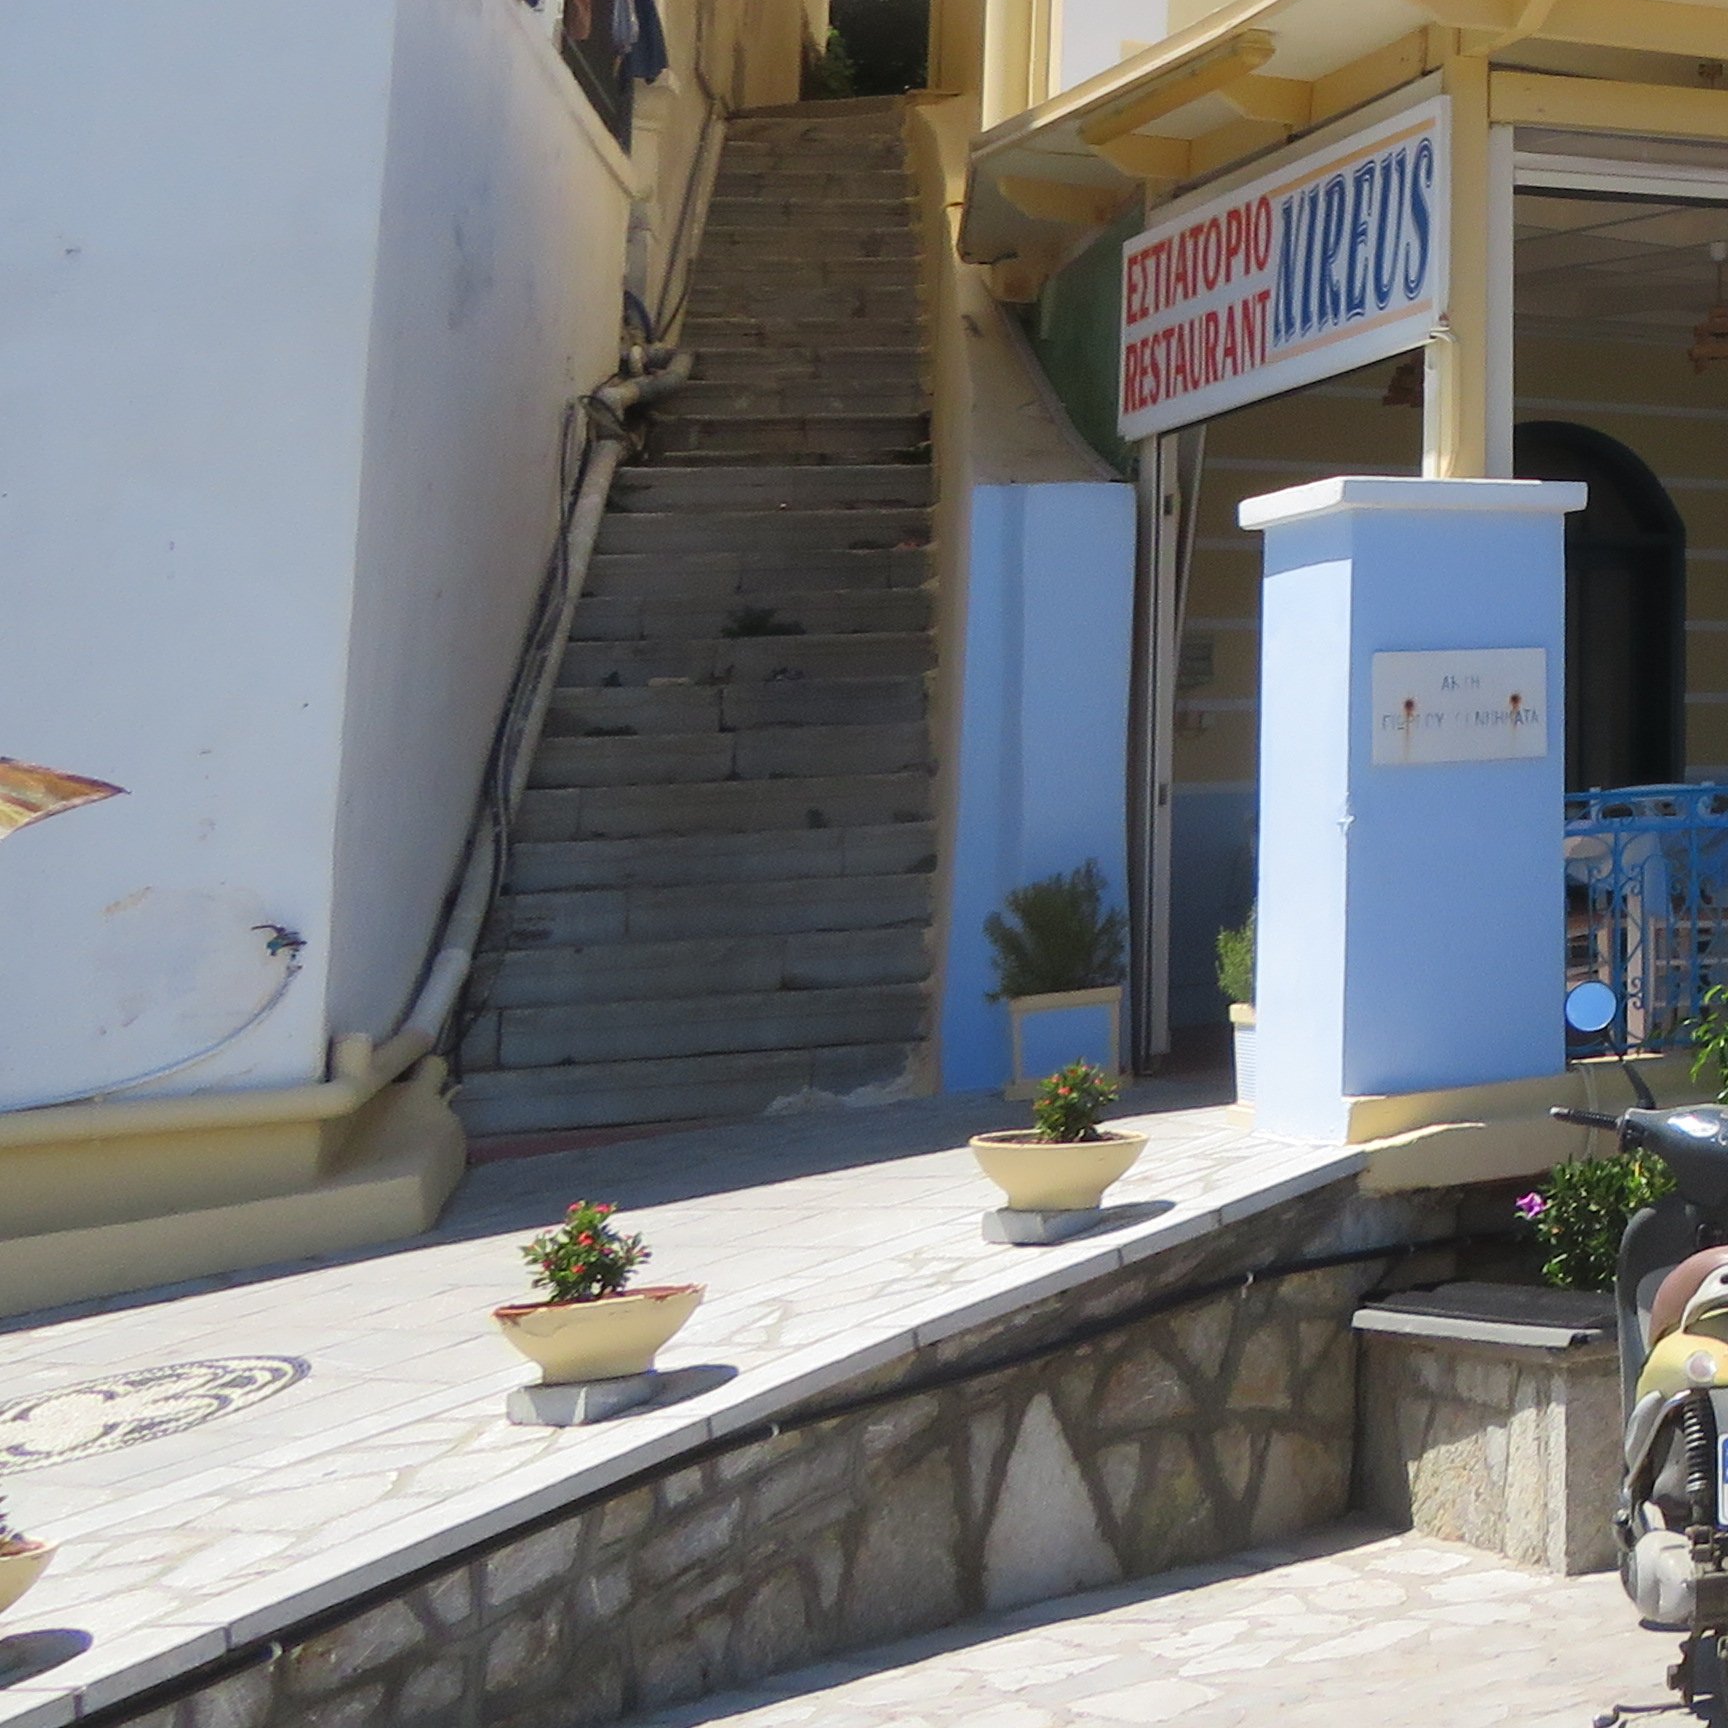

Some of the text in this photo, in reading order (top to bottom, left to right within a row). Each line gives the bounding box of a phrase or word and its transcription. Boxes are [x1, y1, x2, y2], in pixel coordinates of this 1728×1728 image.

[1126, 195, 1273, 326] ΕΣΤΙΑΤΟΡΙΟ
[1273, 137, 1434, 347] NIREUS
[1123, 289, 1271, 415] RESTAURANT
